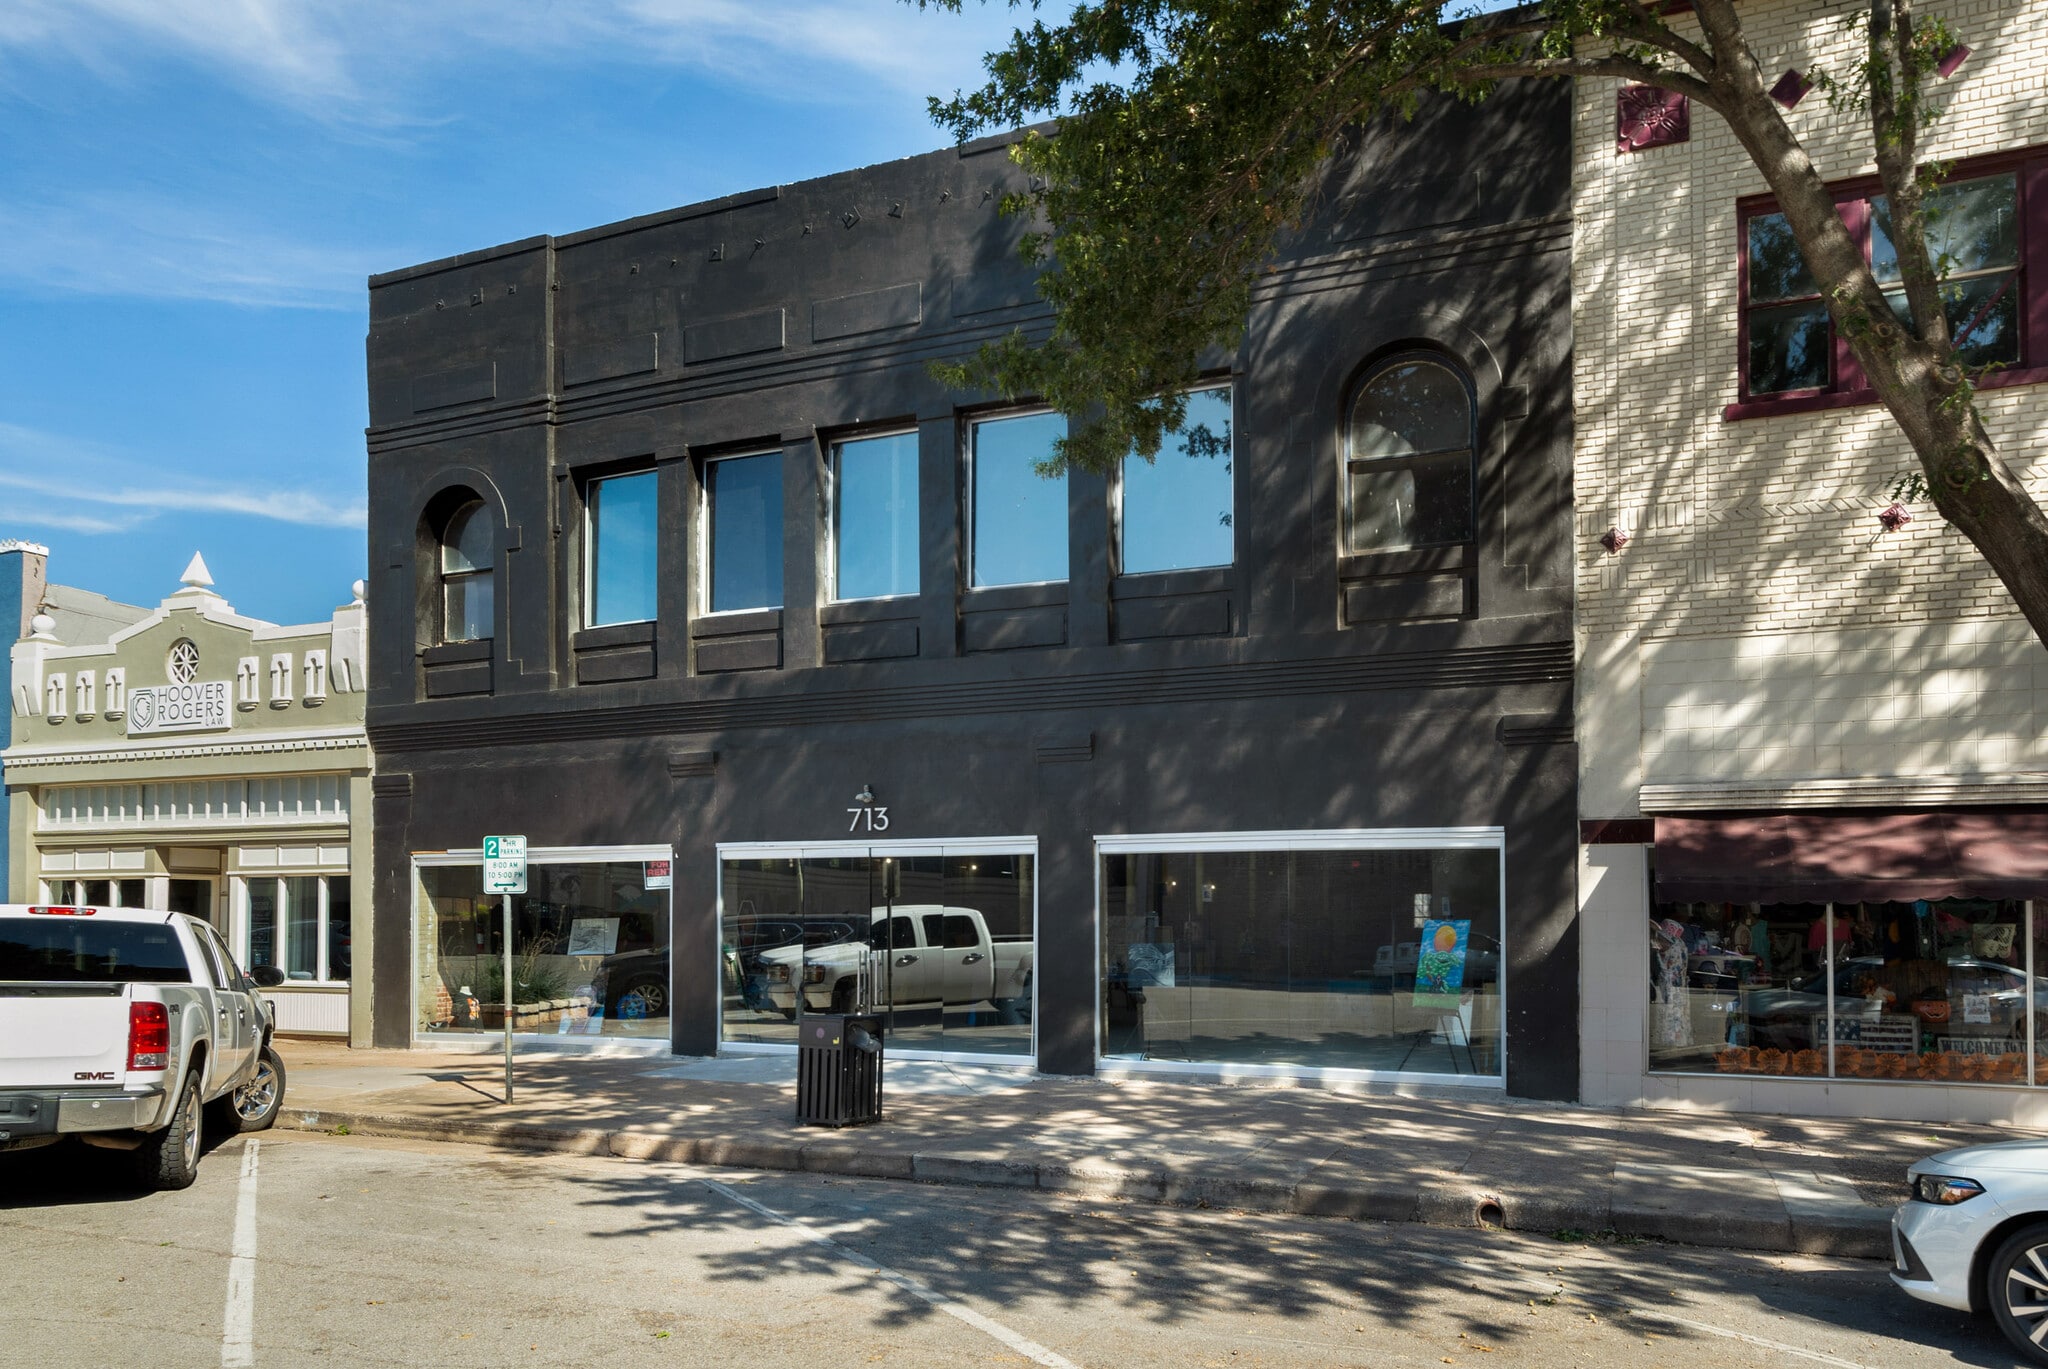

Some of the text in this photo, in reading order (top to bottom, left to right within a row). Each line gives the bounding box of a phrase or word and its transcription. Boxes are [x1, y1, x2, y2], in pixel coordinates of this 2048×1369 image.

[158, 683, 224, 703] HOOVER
[158, 700, 224, 720] ROGERS
[205, 718, 224, 726] LAW
[847, 807, 889, 831] 713
[487, 840, 497, 856] 2
[74, 1072, 115, 1081] GMC
